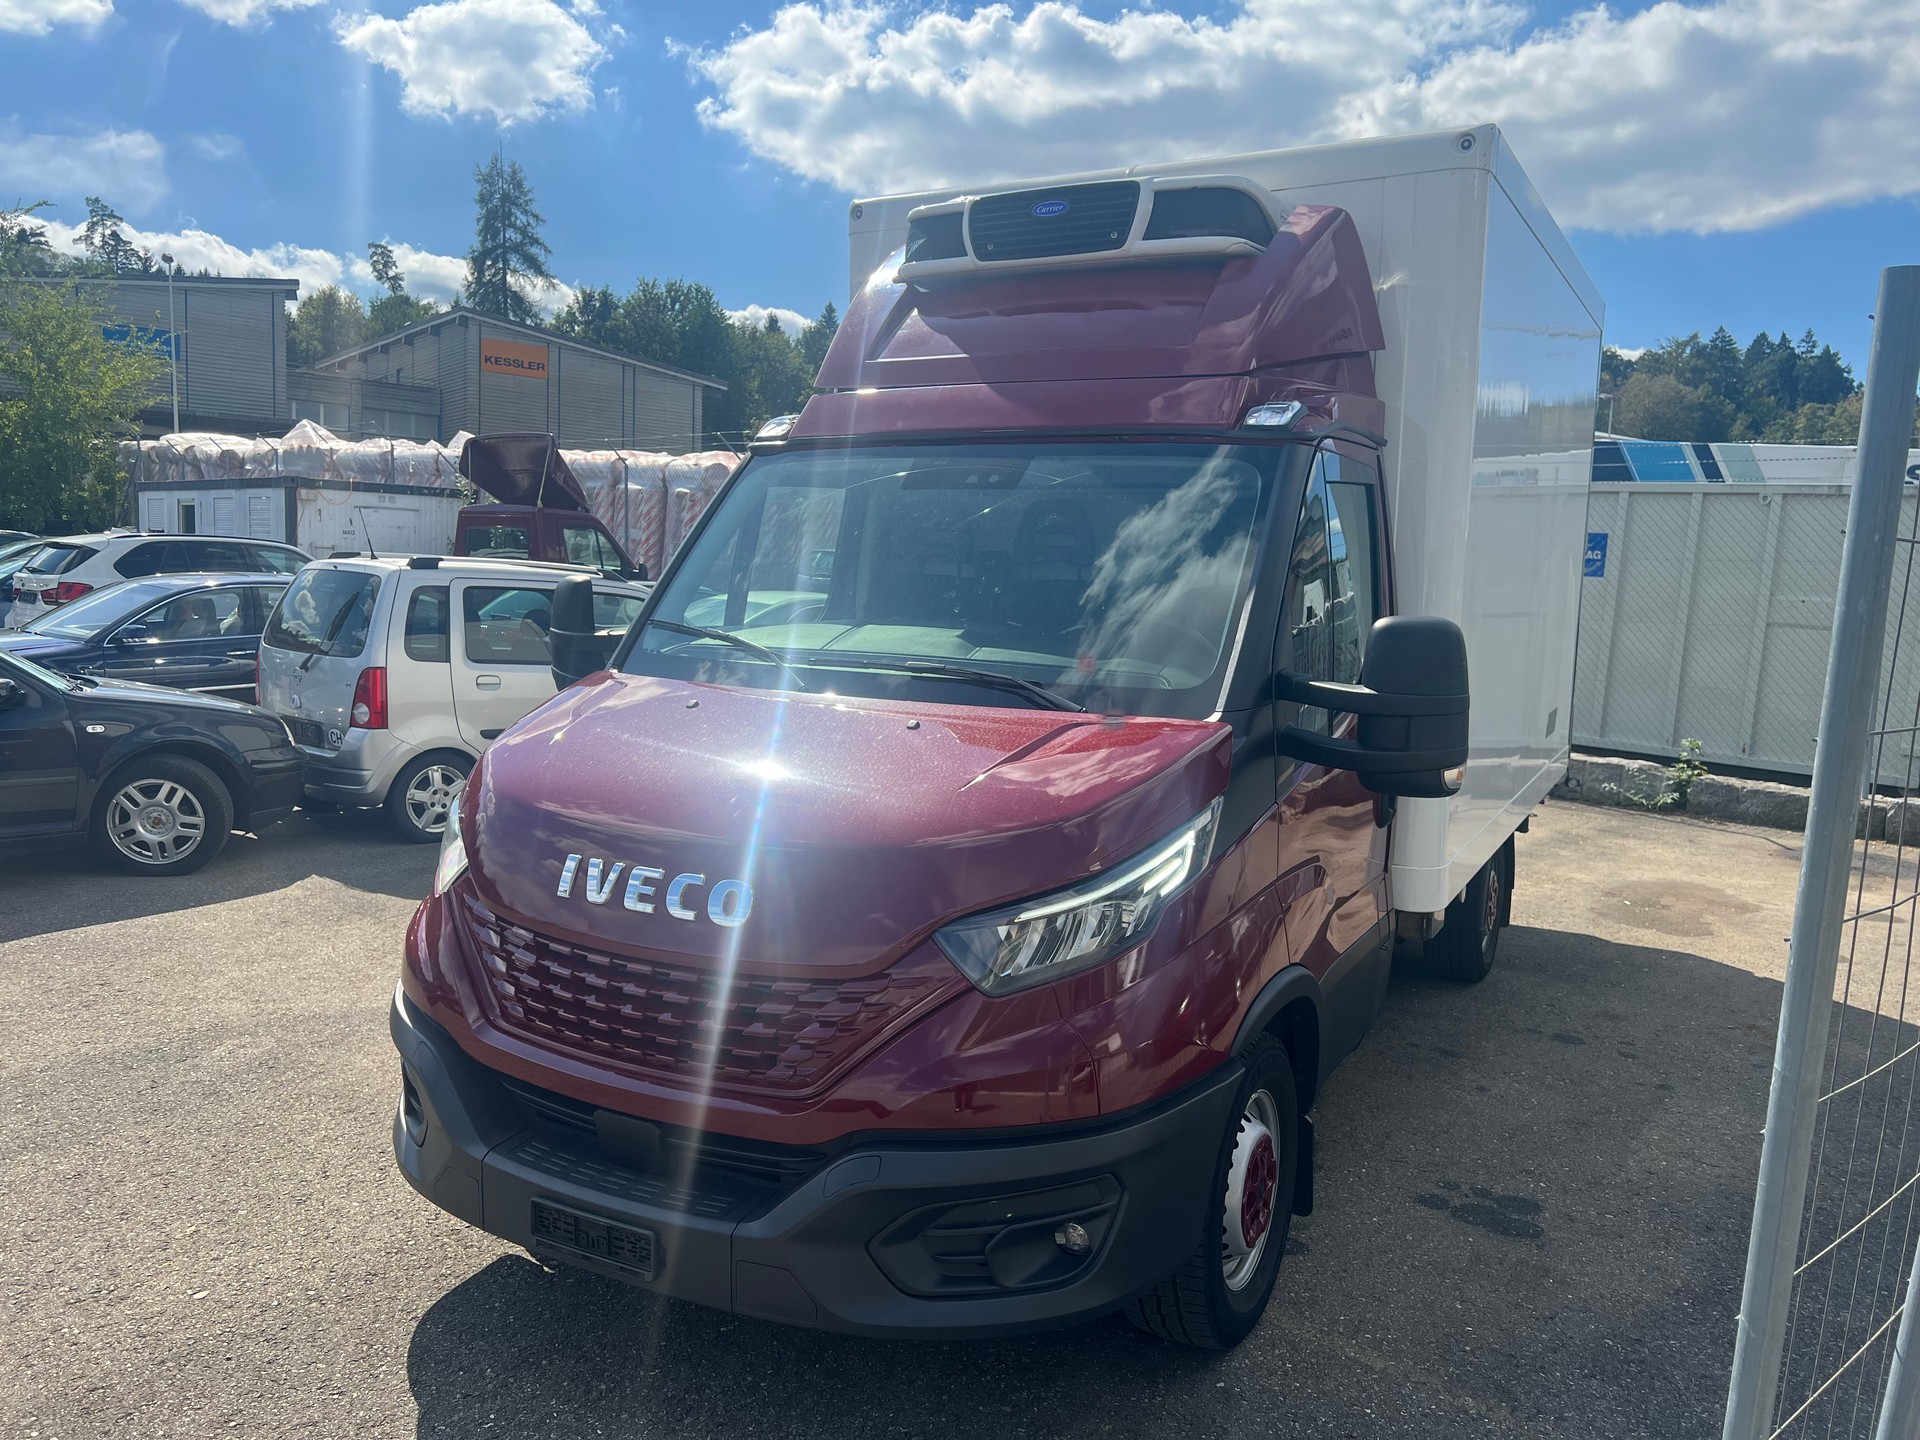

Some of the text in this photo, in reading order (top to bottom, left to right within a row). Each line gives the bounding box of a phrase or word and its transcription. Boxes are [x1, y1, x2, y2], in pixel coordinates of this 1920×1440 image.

[1036, 204, 1064, 214] Carrier
[484, 354, 546, 372] KESSLER
[330, 730, 343, 745] CH
[557, 853, 754, 928] IVECO
